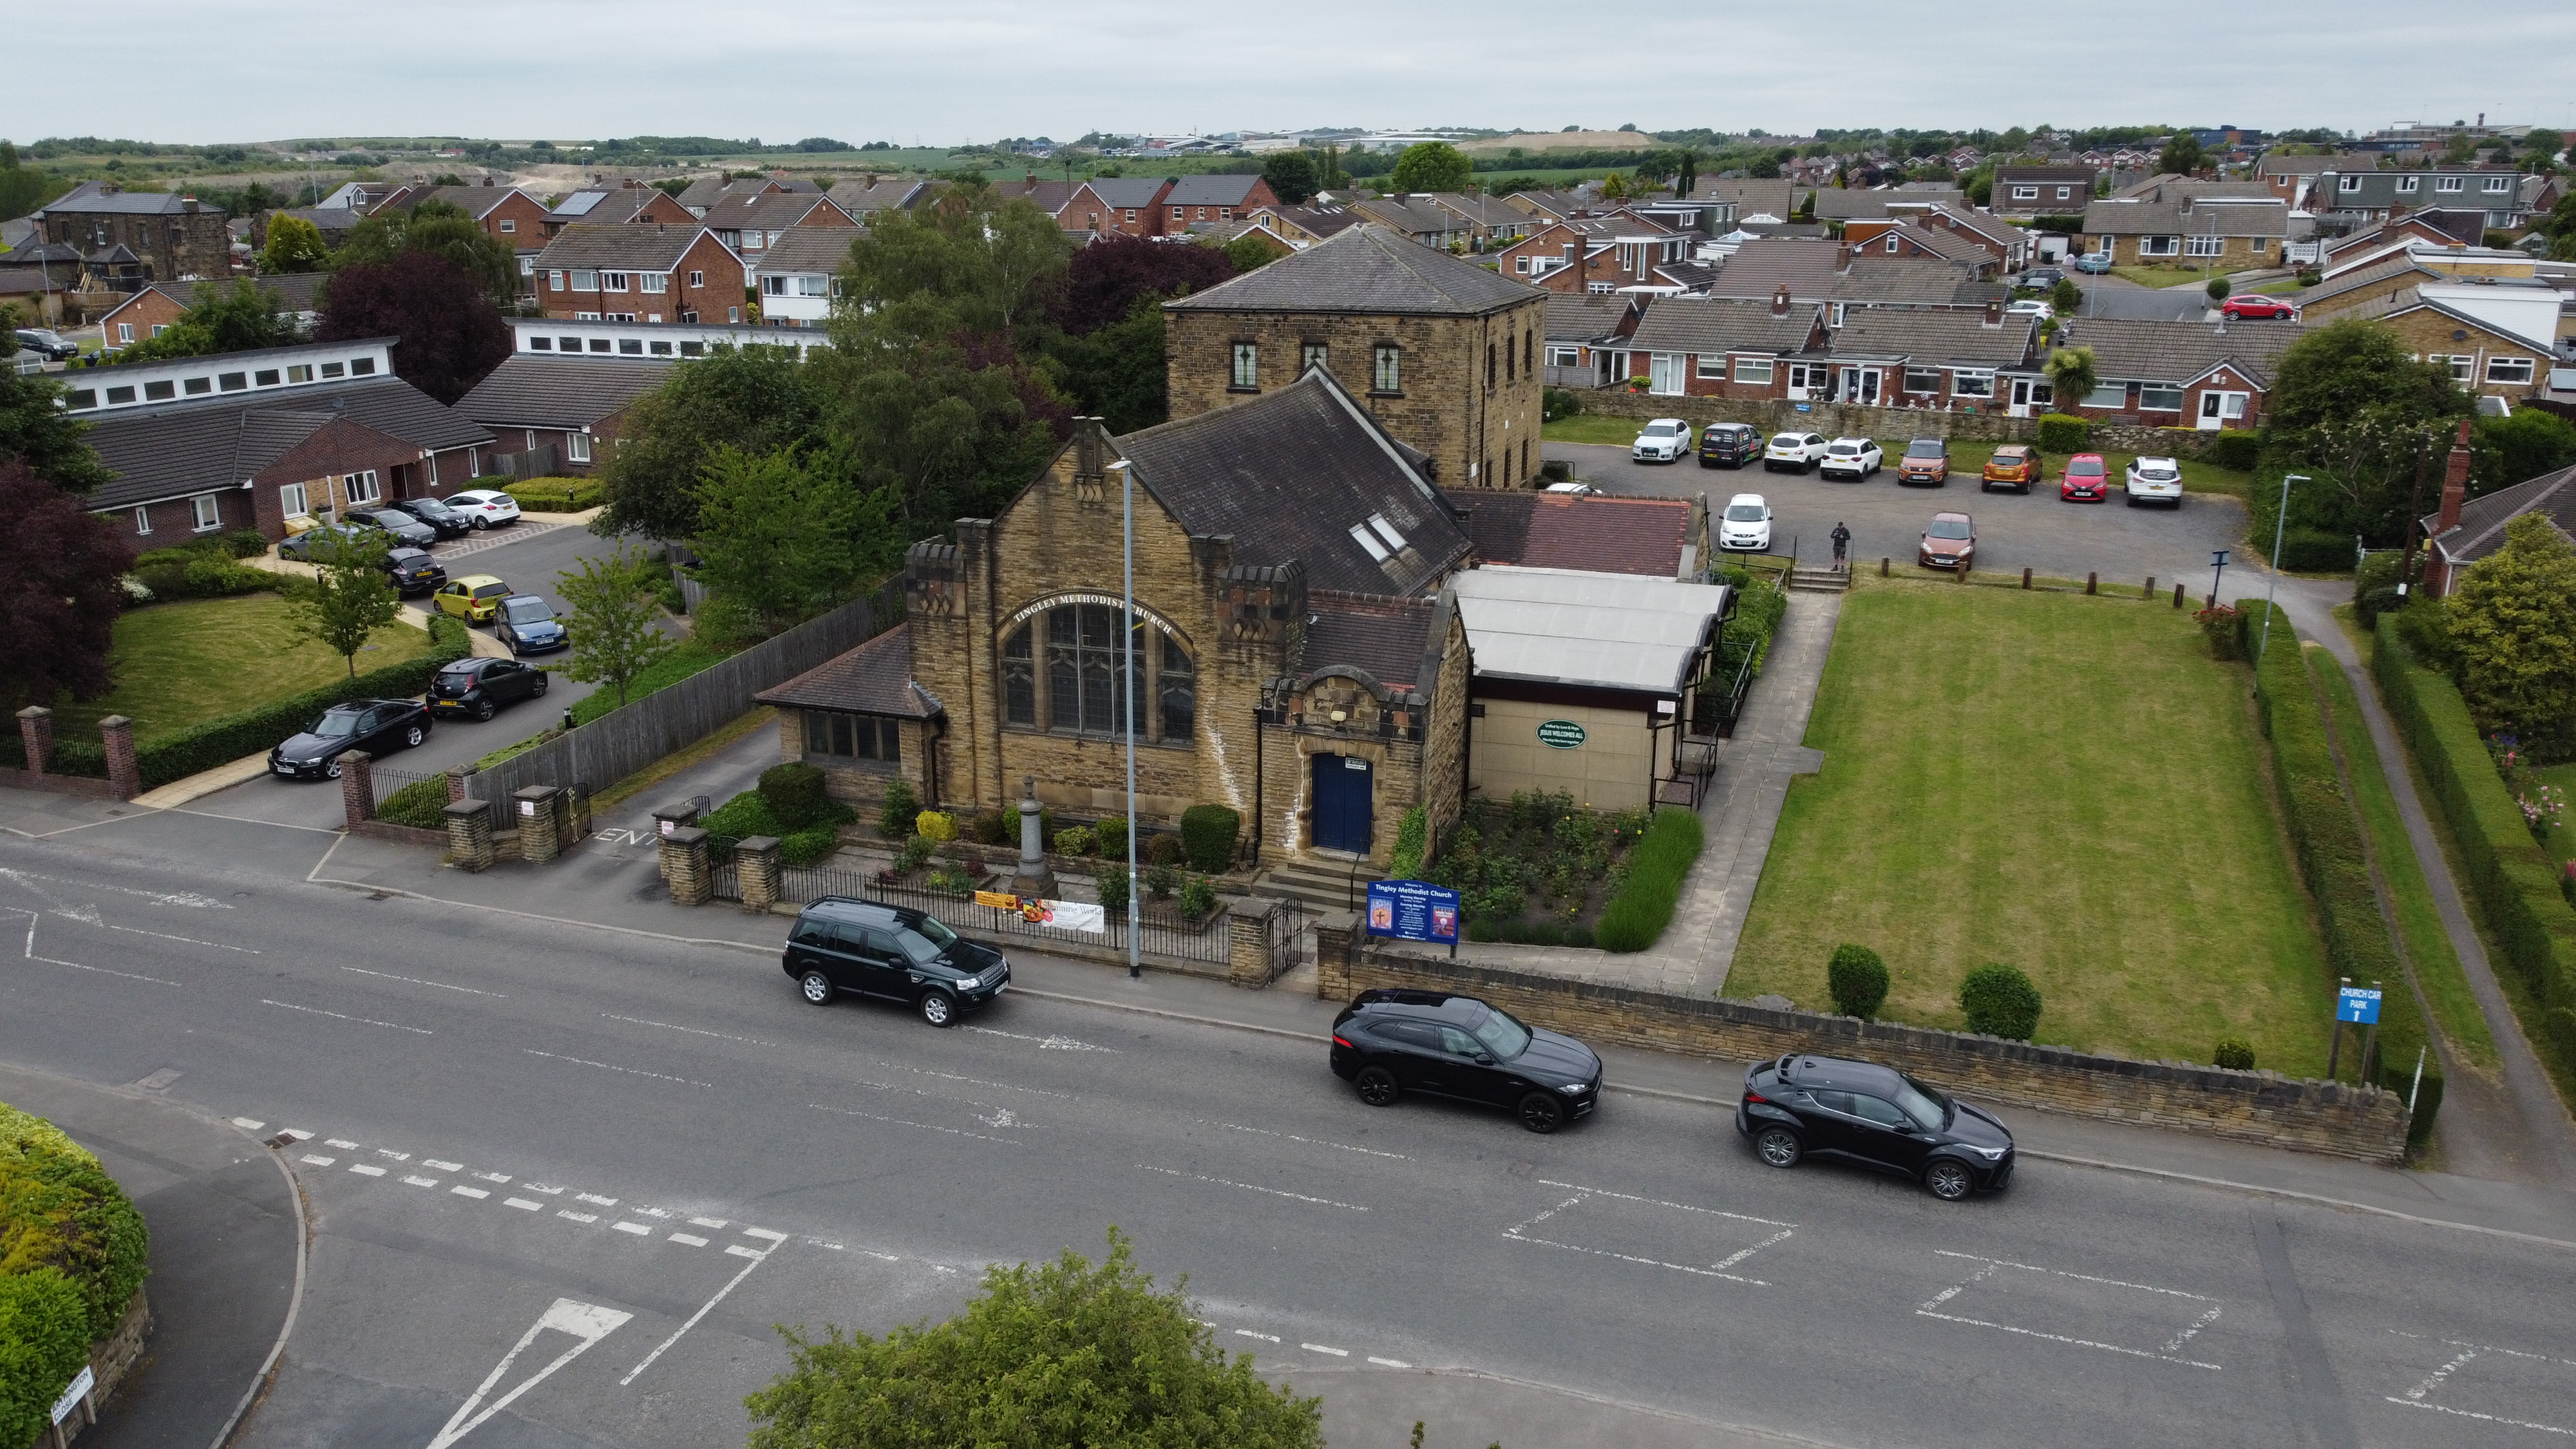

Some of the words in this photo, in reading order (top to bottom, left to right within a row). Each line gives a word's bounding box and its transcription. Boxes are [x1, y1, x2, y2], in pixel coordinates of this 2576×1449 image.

[1014, 598, 1056, 622] TINGLEY
[1059, 594, 1125, 609] METHODIST
[1375, 884, 1397, 893] Tingley
[1398, 887, 1429, 896] Methodist
[1430, 890, 1452, 898] Church
[1043, 902, 1077, 914] Slimming
[1080, 905, 1102, 915] World
[2340, 987, 2367, 998] CHURCH
[2368, 990, 2382, 1000] CAR
[2350, 999, 2367, 1010] PARK
[54, 1397, 73, 1421] CLOSE
